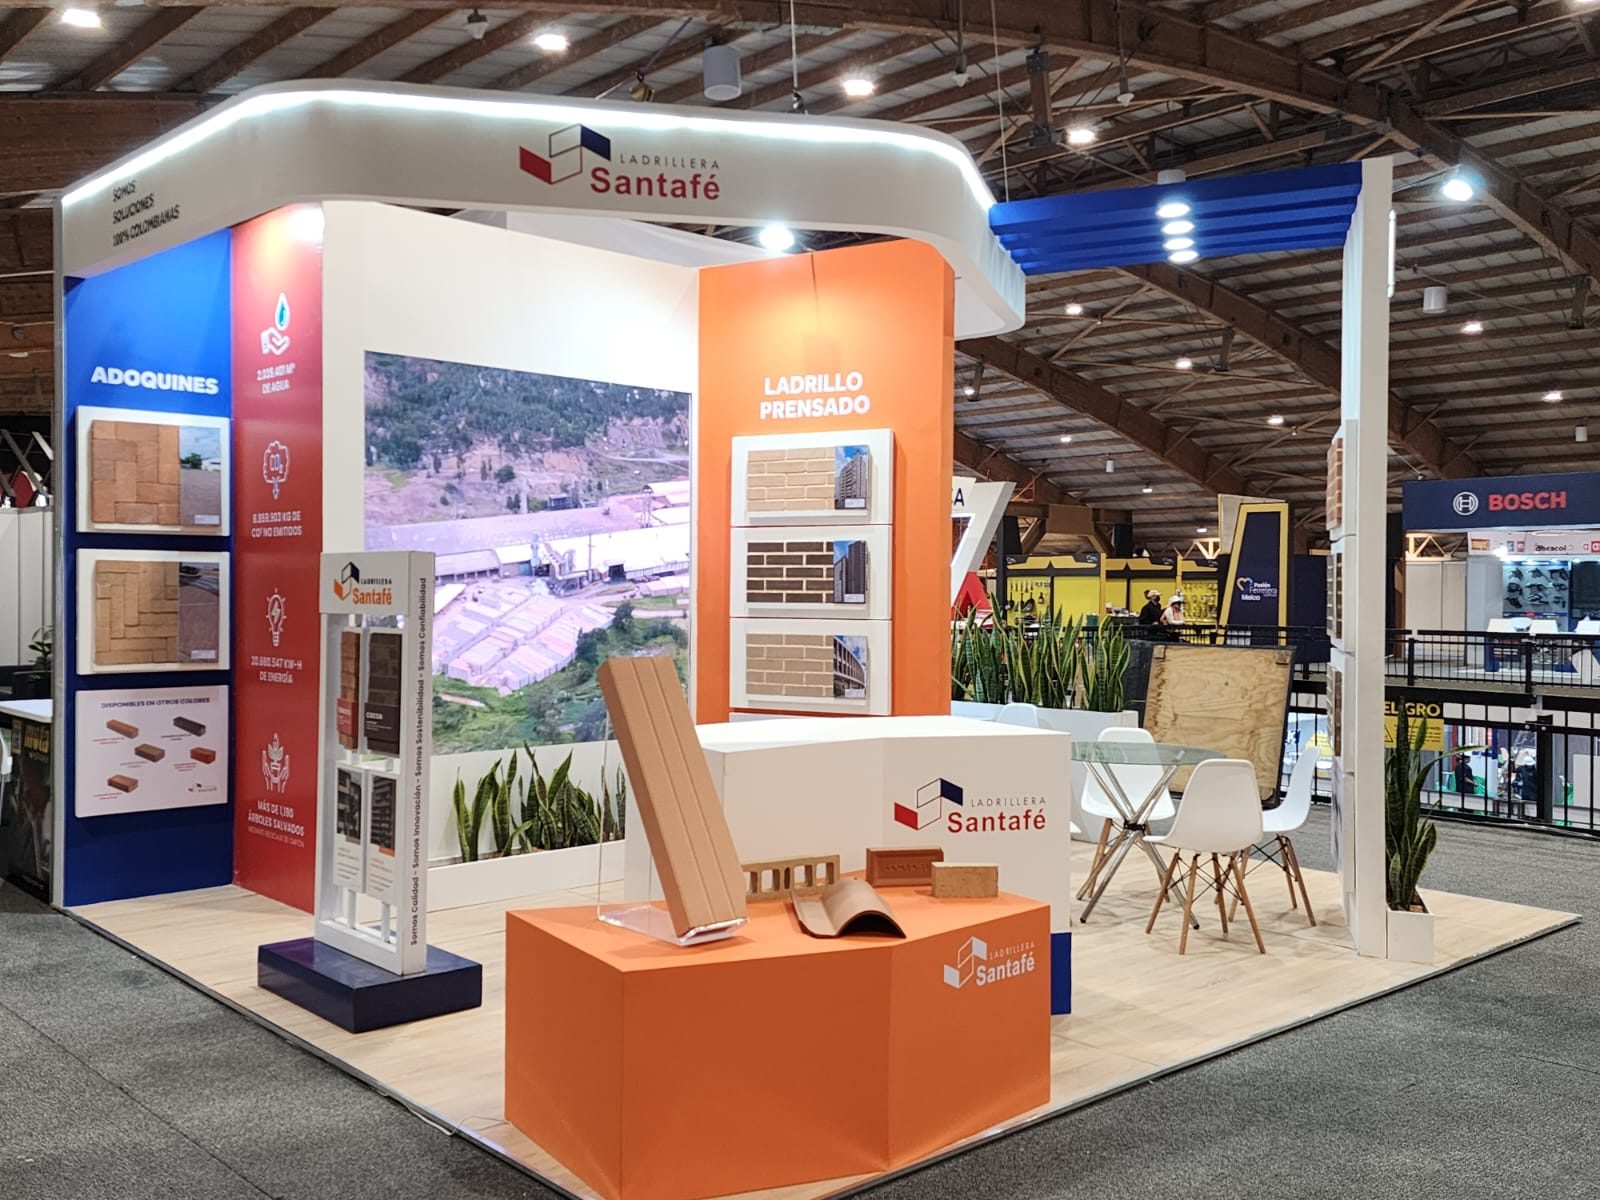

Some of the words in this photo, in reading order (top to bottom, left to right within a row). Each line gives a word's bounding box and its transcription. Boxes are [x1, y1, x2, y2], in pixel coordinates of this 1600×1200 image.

[620, 154, 720, 170] LADRILLERA
[112, 180, 136, 202] SOMOS
[590, 166, 720, 200] Santafé
[112, 193, 154, 224] SOLUCIONES
[112, 230, 129, 247] 100%
[130, 204, 180, 239] COLOMBIANAS
[91, 366, 219, 395] ADOQUINES
[262, 382, 271, 394] DE
[271, 379, 290, 392] AGUA
[764, 371, 863, 395] LADRILLO
[759, 395, 870, 420] PRENSADO
[1488, 491, 1567, 511] BOSCH
[292, 510, 301, 521] DE
[263, 527, 272, 537] NO
[273, 525, 303, 537] EMITIDOS
[352, 588, 392, 605] Santafé
[418, 578, 426, 639] Confiabilidad
[260, 671, 267, 682] DE
[267, 670, 294, 684] ENERGÍA
[101, 700, 145, 709] DISPONIBLES
[416, 680, 424, 745] Sostenibilidad
[1384, 701, 1441, 717] ELGRO
[257, 799, 270, 812] MÁS
[271, 803, 279, 815] DE
[413, 785, 421, 836] Innovación
[971, 796, 1046, 808] LADRILLERA
[248, 809, 272, 827] ÁRBOLES
[273, 818, 304, 837] SALVADOS
[947, 808, 1046, 834] Santafé
[412, 837, 420, 868] Somos
[411, 877, 419, 912] Calidad
[989, 941, 1035, 960] LADRILLERA
[975, 951, 1035, 986] Santafé
